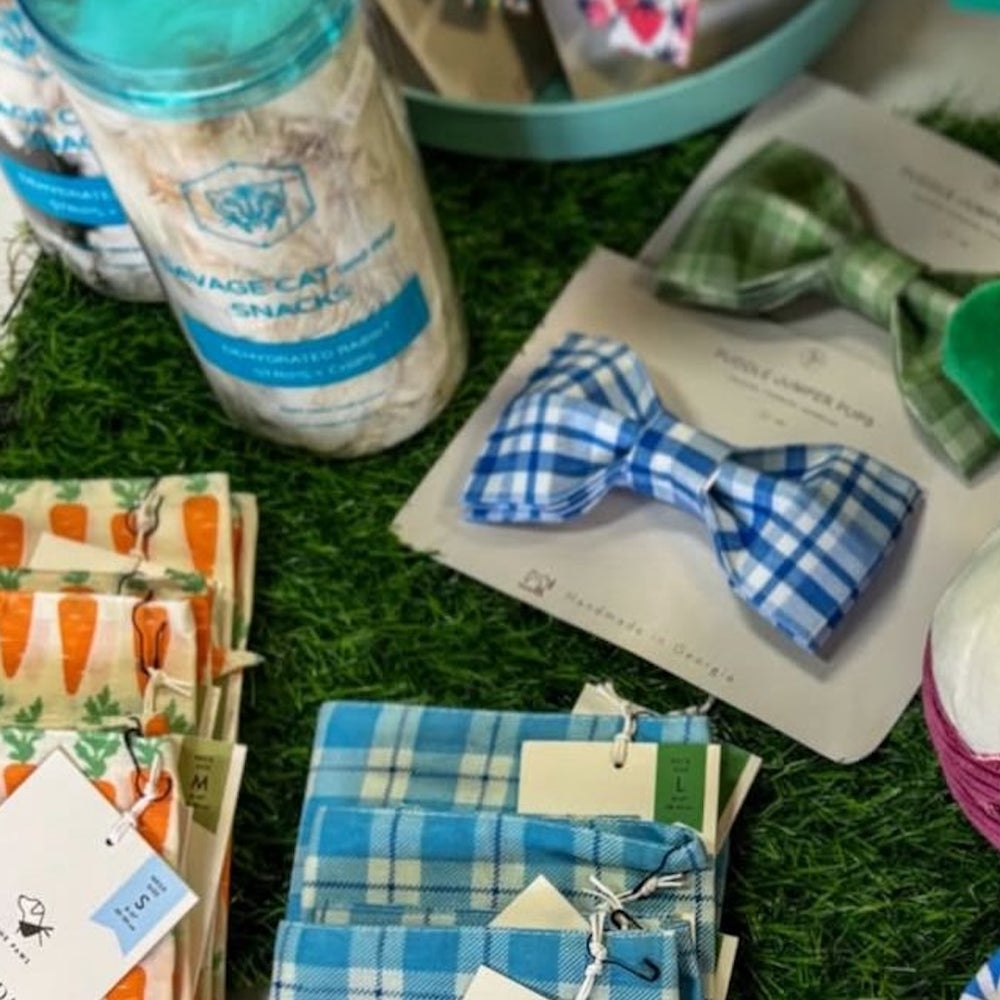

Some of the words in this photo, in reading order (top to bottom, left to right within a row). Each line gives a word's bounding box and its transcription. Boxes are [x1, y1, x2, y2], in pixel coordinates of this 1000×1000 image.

[275, 265, 330, 291] CAT
[229, 286, 352, 318] SNACKS
[191, 774, 208, 792] M
[676, 775, 687, 793] L
[134, 894, 150, 910] S
